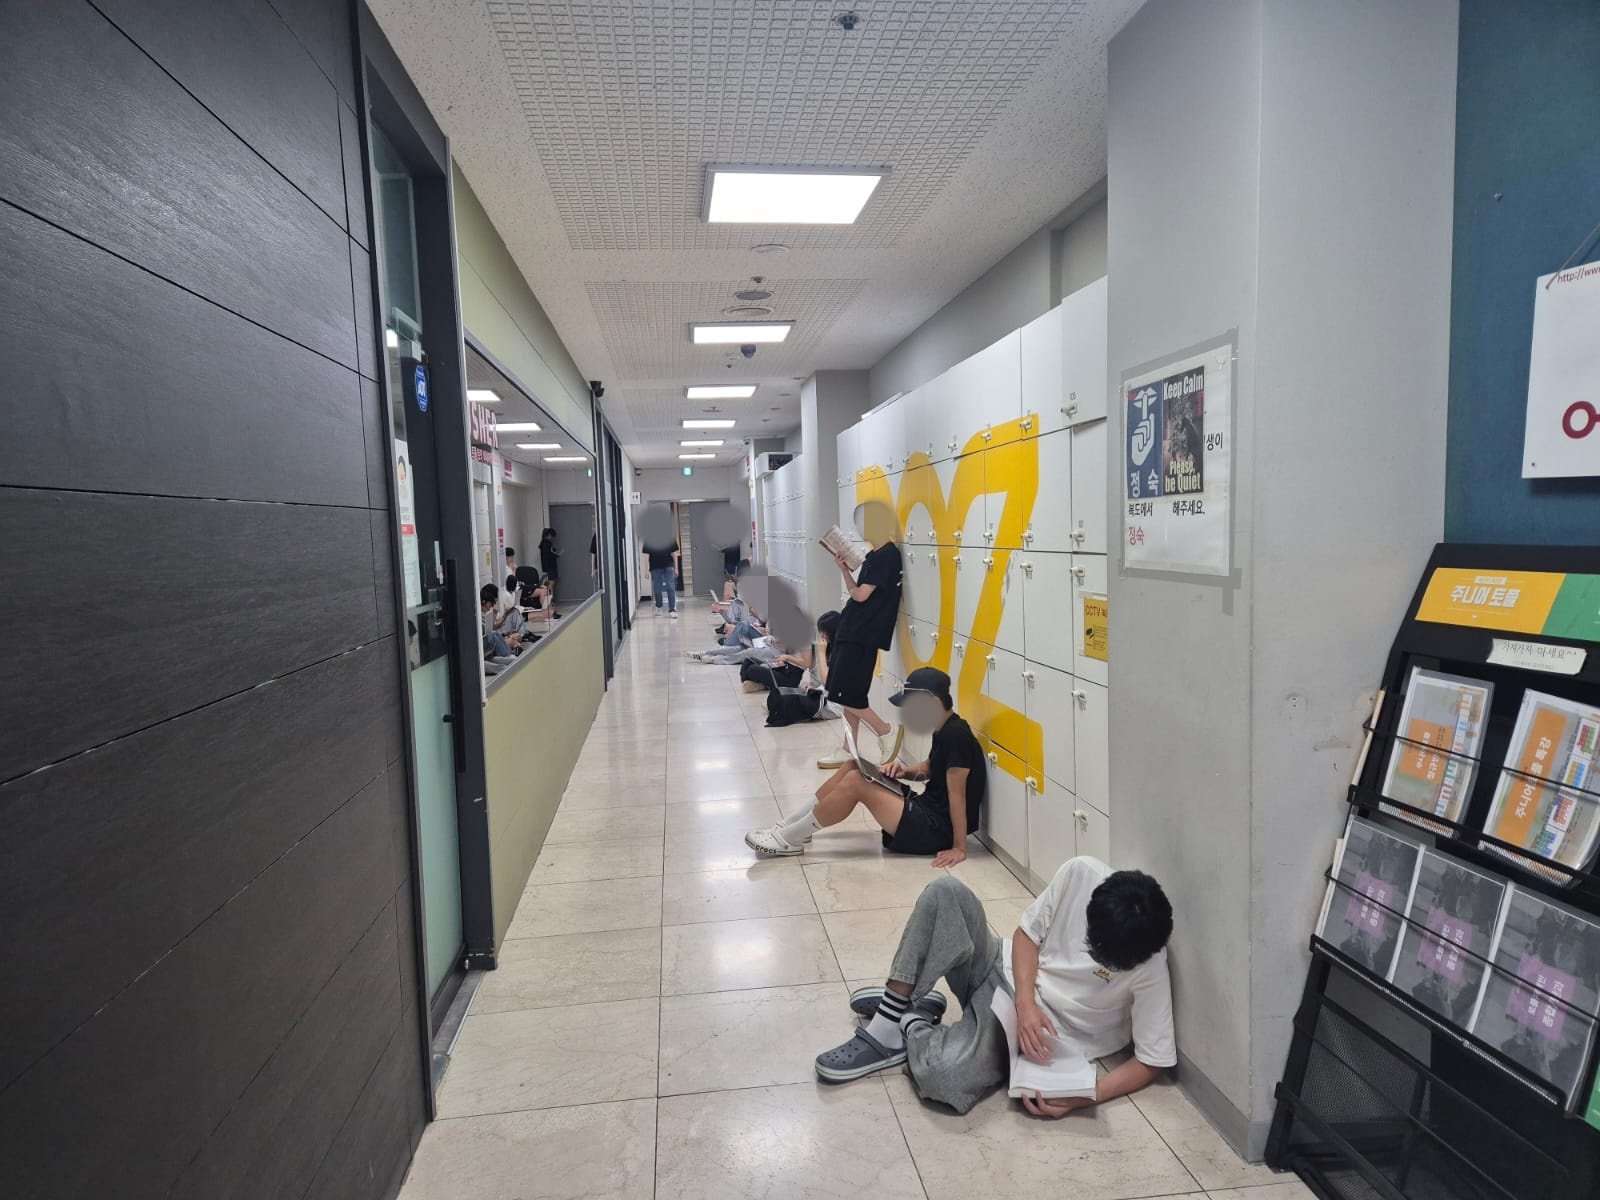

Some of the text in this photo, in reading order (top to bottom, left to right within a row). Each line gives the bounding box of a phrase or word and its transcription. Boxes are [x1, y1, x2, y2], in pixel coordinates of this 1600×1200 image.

[1164, 373, 1204, 400] Keep Calm
[1165, 472, 1201, 493] be Quiet
[1128, 502, 1153, 517] 복도에서
[1128, 526, 1145, 546] 정숙
[1451, 585, 1521, 608] 주니어 토플
